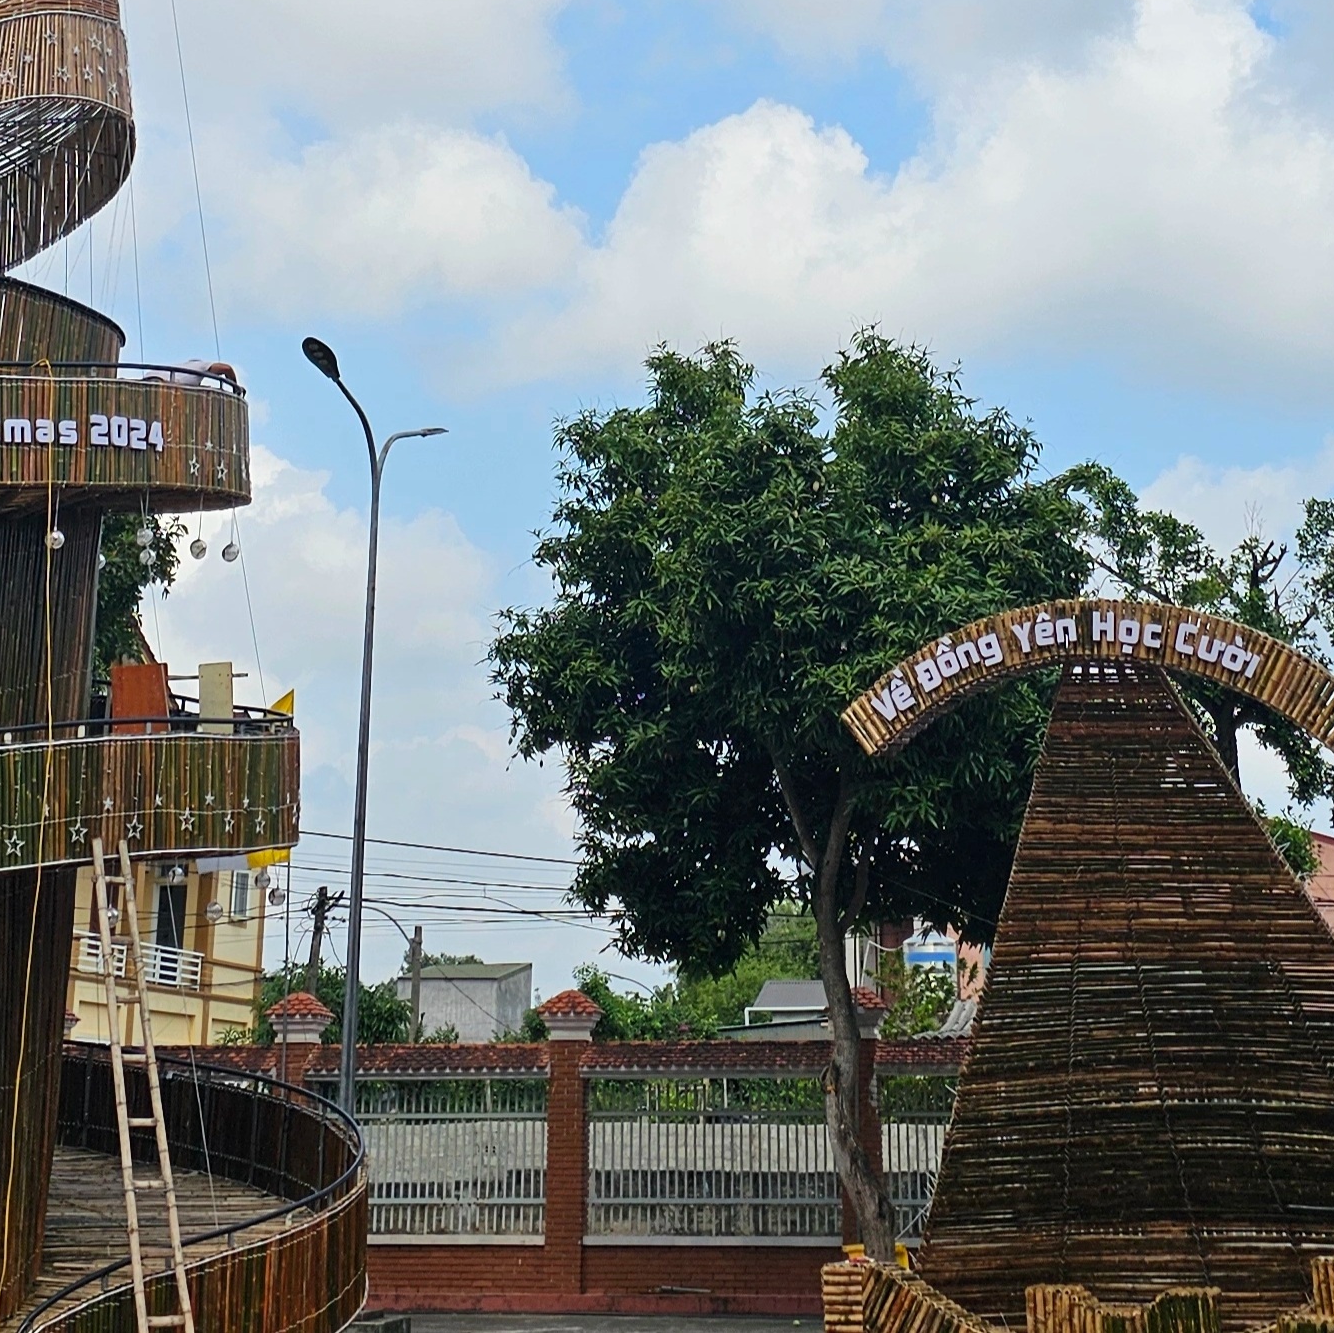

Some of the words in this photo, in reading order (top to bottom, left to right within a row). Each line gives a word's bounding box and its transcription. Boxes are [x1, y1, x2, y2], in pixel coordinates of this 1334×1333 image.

[89, 414, 164, 451] 2024
[871, 667, 917, 722] Về
[914, 635, 1004, 693] Đồng
[1012, 611, 1076, 653] Yên
[1092, 611, 1163, 654] Học
[1175, 622, 1260, 679] Cười
